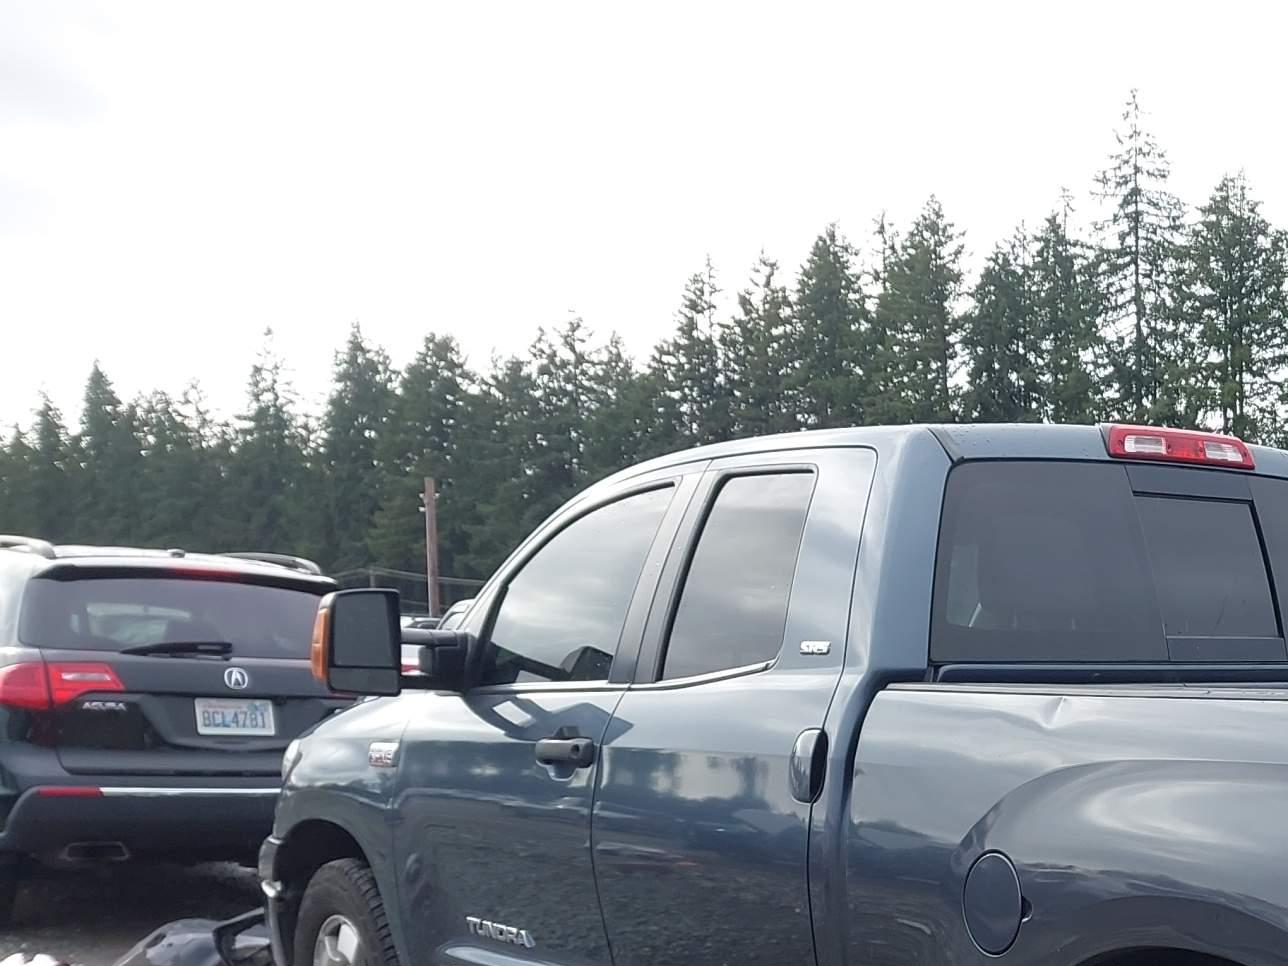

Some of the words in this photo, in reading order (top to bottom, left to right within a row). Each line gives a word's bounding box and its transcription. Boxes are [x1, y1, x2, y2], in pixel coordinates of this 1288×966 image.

[83, 701, 127, 711] ACURA
[203, 709, 267, 729] BCL4781
[466, 916, 536, 949] TUNDRA
